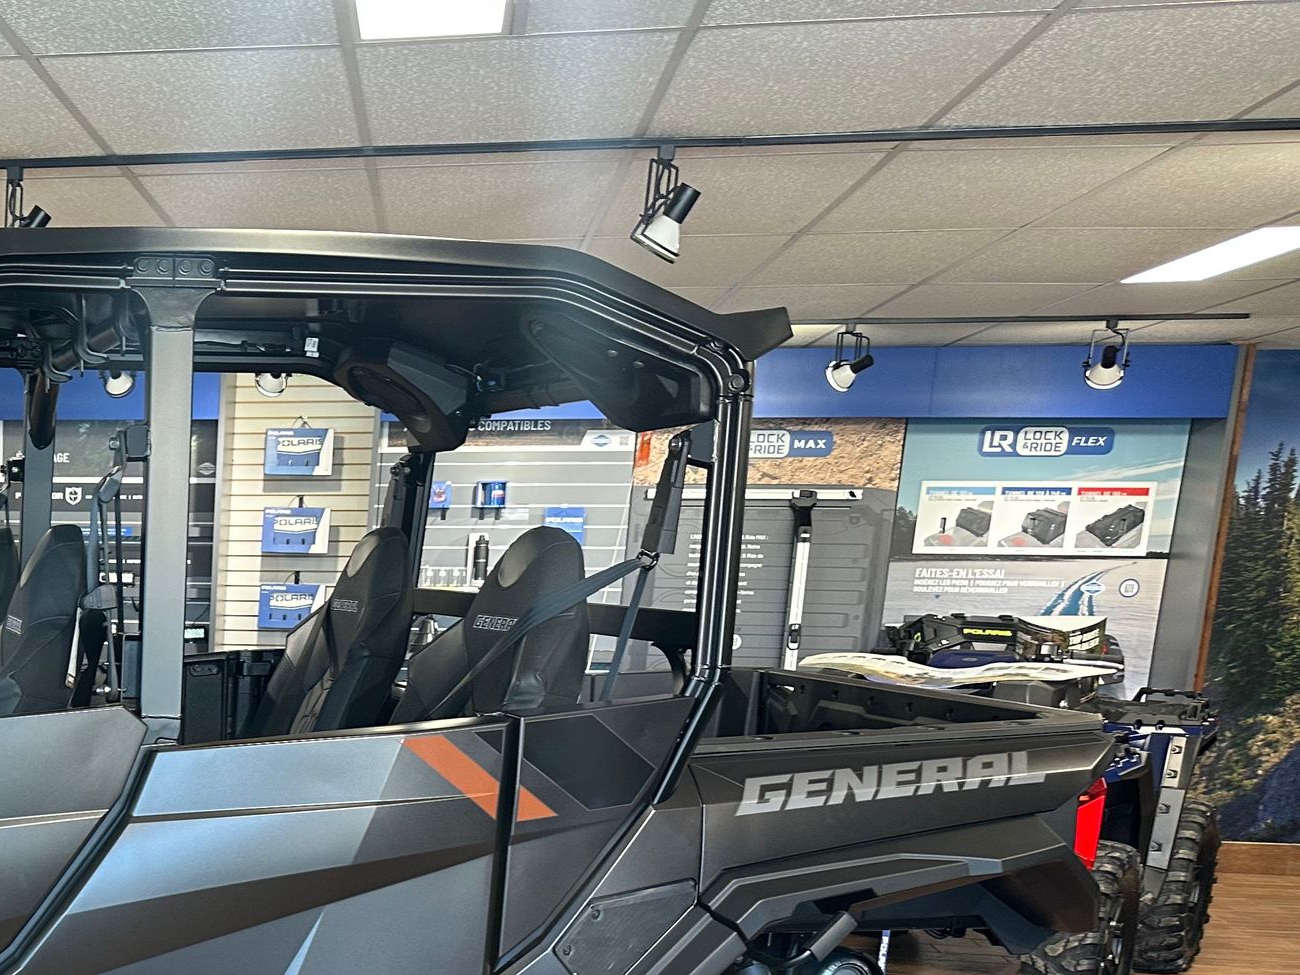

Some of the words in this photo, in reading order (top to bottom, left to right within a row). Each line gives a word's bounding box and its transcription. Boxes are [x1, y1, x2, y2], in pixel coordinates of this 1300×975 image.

[477, 420, 552, 431] COMPATIBLES
[750, 433, 785, 443] OCK
[793, 439, 827, 449] MAX
[982, 430, 1014, 453] LR
[1024, 430, 1064, 441] LOCK
[1071, 436, 1108, 447] FLEX
[914, 568, 967, 578] FAITES-EN
[735, 750, 1049, 817] GENERAL
